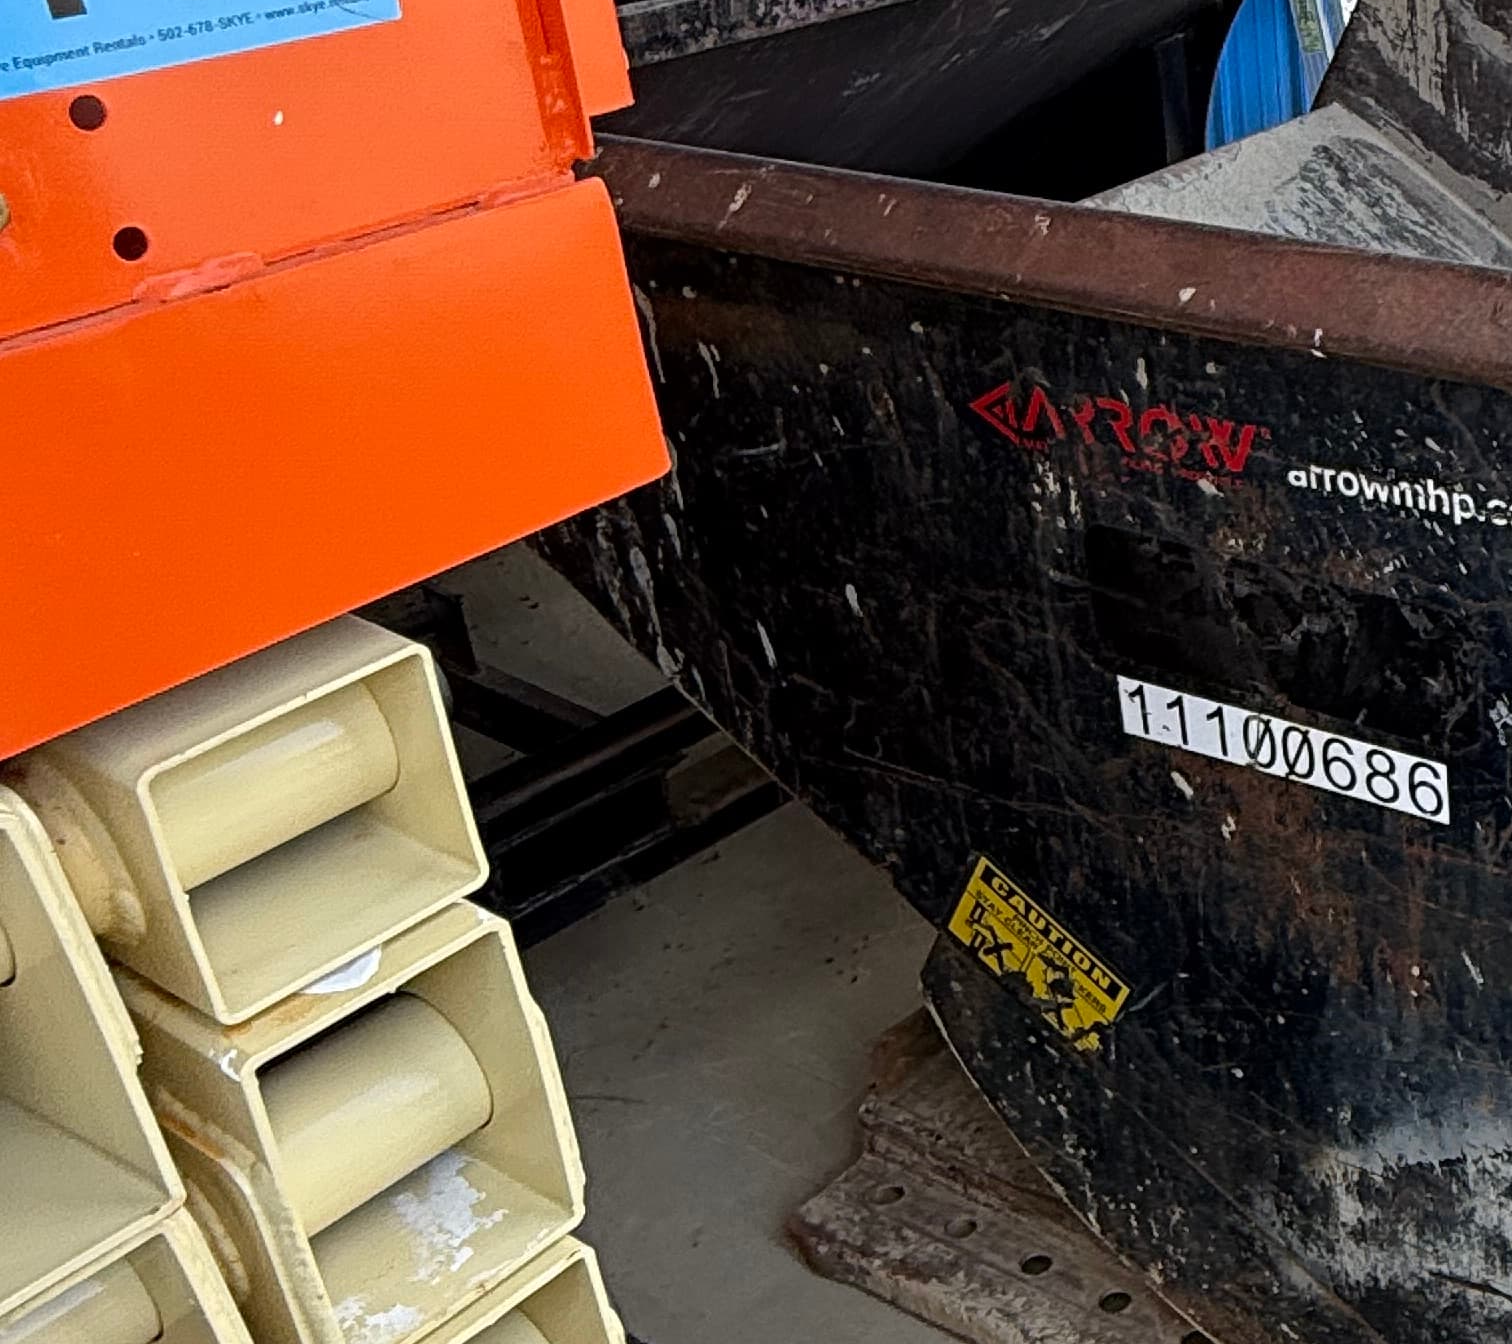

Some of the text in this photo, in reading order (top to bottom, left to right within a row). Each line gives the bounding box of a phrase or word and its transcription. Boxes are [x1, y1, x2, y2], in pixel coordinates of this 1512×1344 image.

[12, 46, 90, 69] Equipment
[92, 34, 146, 54] Rentals
[158, 11, 254, 42] 502-678-SKYE
[1127, 683, 1444, 818] 11100686
[991, 876, 1111, 990] CAUTION
